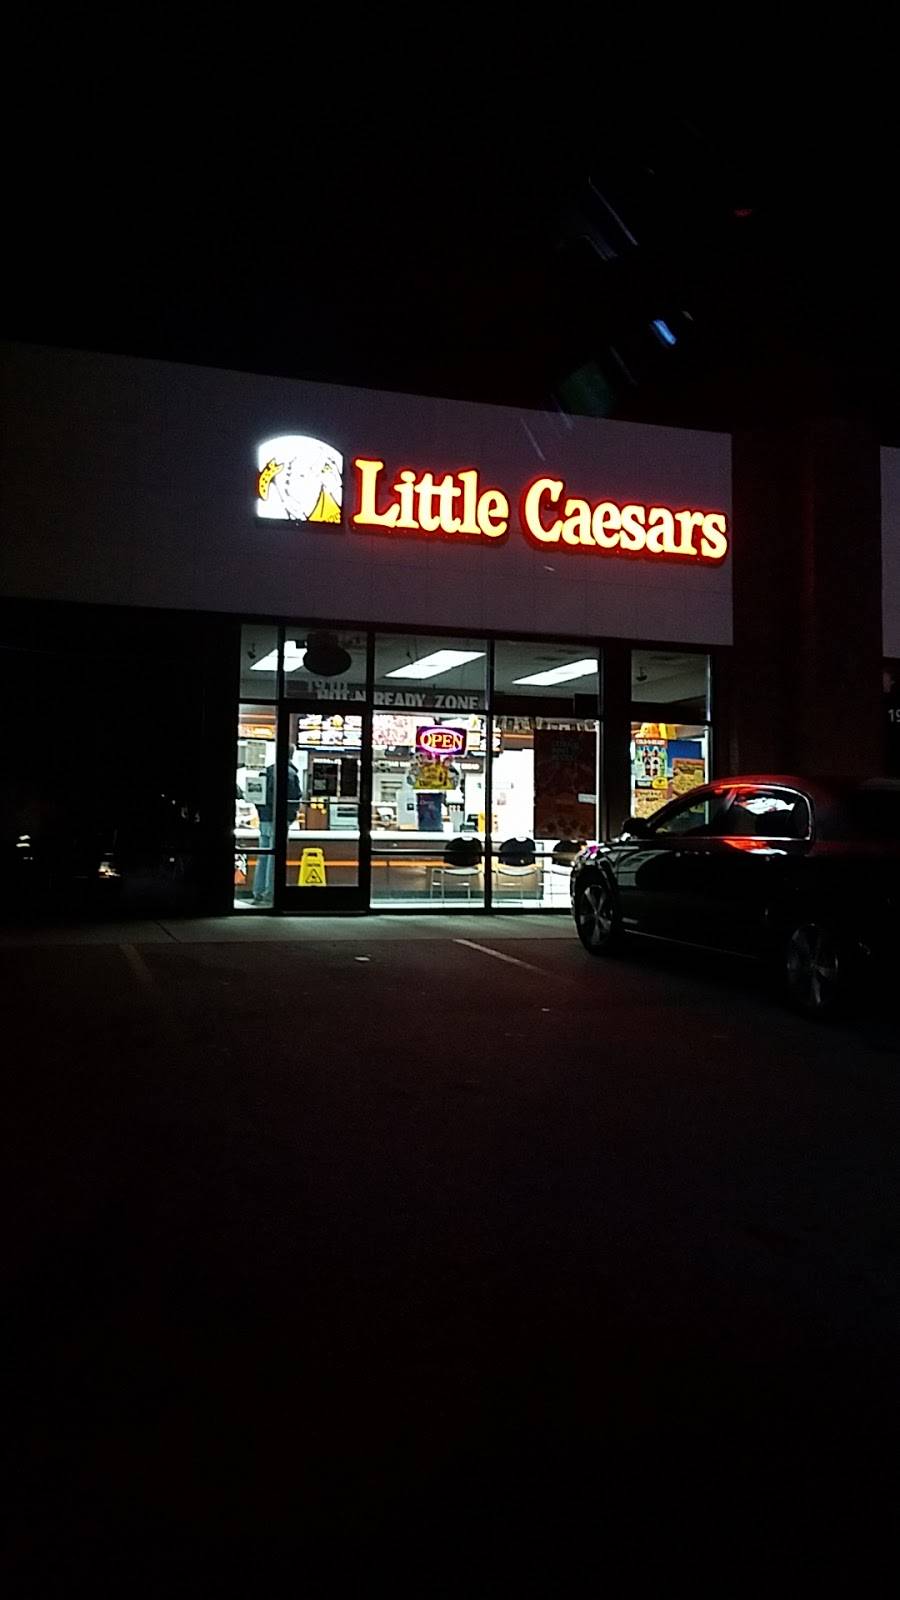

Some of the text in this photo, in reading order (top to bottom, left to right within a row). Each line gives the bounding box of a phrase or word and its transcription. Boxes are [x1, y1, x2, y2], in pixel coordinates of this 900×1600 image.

[354, 458, 728, 559] Little Caesars
[434, 695, 480, 710] ZONE
[419, 732, 463, 749] OPEN
